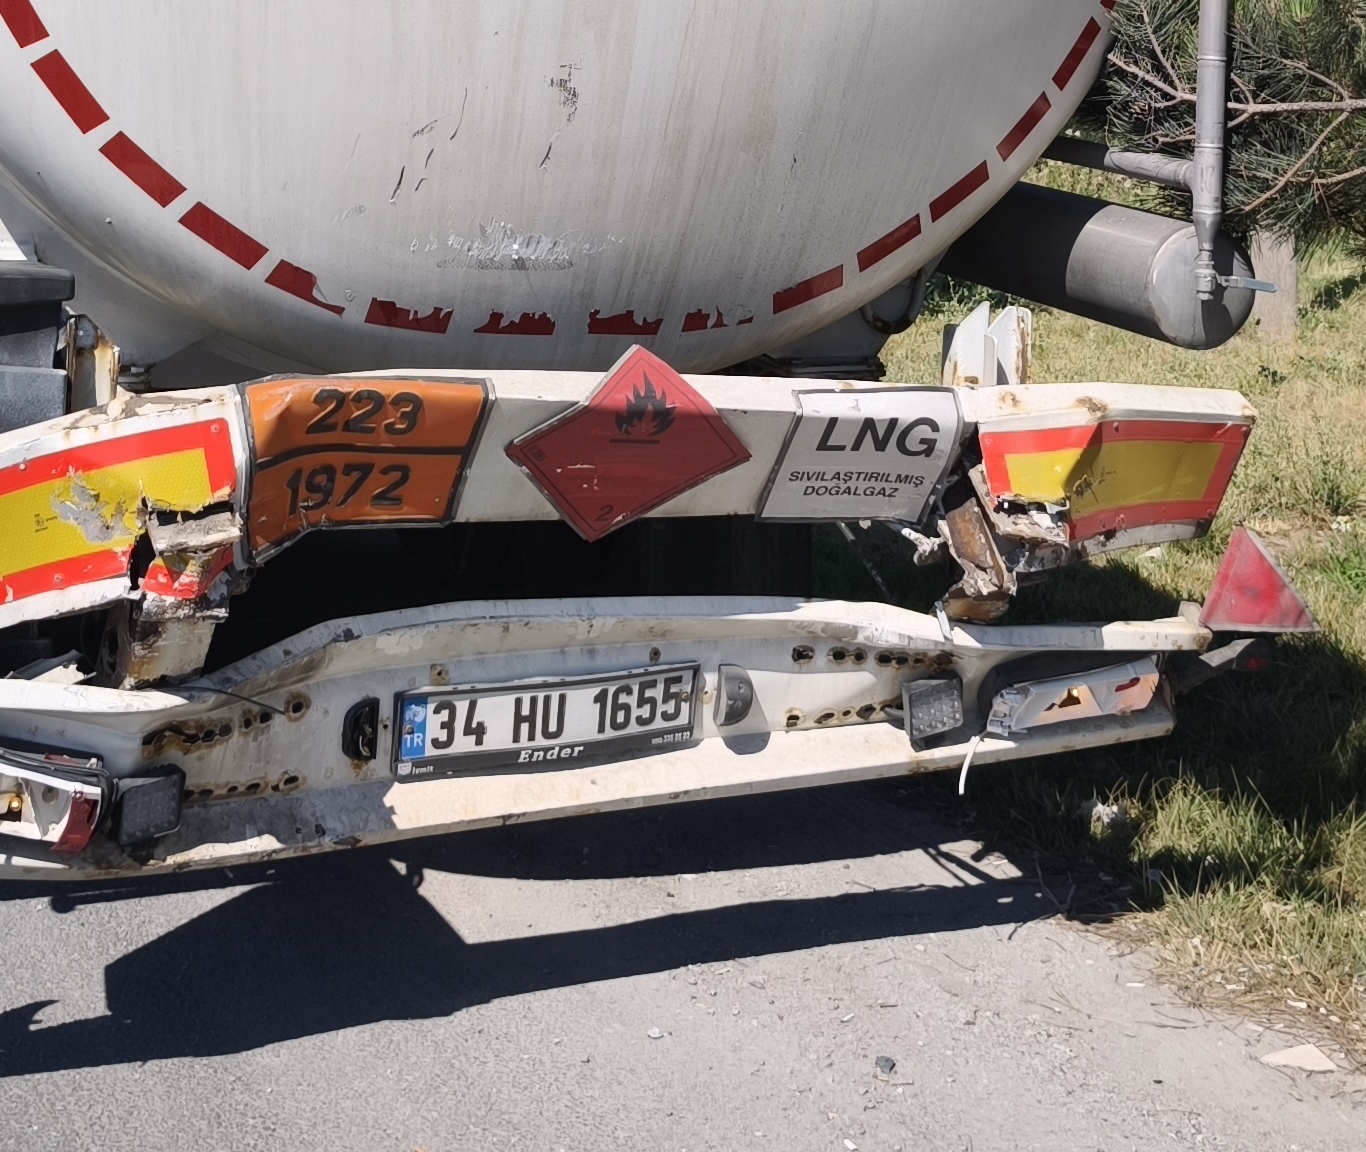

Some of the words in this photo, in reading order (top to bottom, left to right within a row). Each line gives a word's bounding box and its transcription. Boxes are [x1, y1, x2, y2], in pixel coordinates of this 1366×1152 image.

[305, 388, 425, 436] 223
[815, 416, 941, 458] LNG
[788, 470, 926, 488] SIVILAŞTIRILMIŞ
[285, 462, 412, 517] 1972
[803, 483, 900, 498] DOĞALGAZ
[595, 504, 614, 522] 2
[430, 699, 487, 750] 34
[512, 692, 568, 744] HU
[593, 675, 684, 735] 1655
[403, 732, 424, 748] TR
[517, 746, 584, 763] Ender
